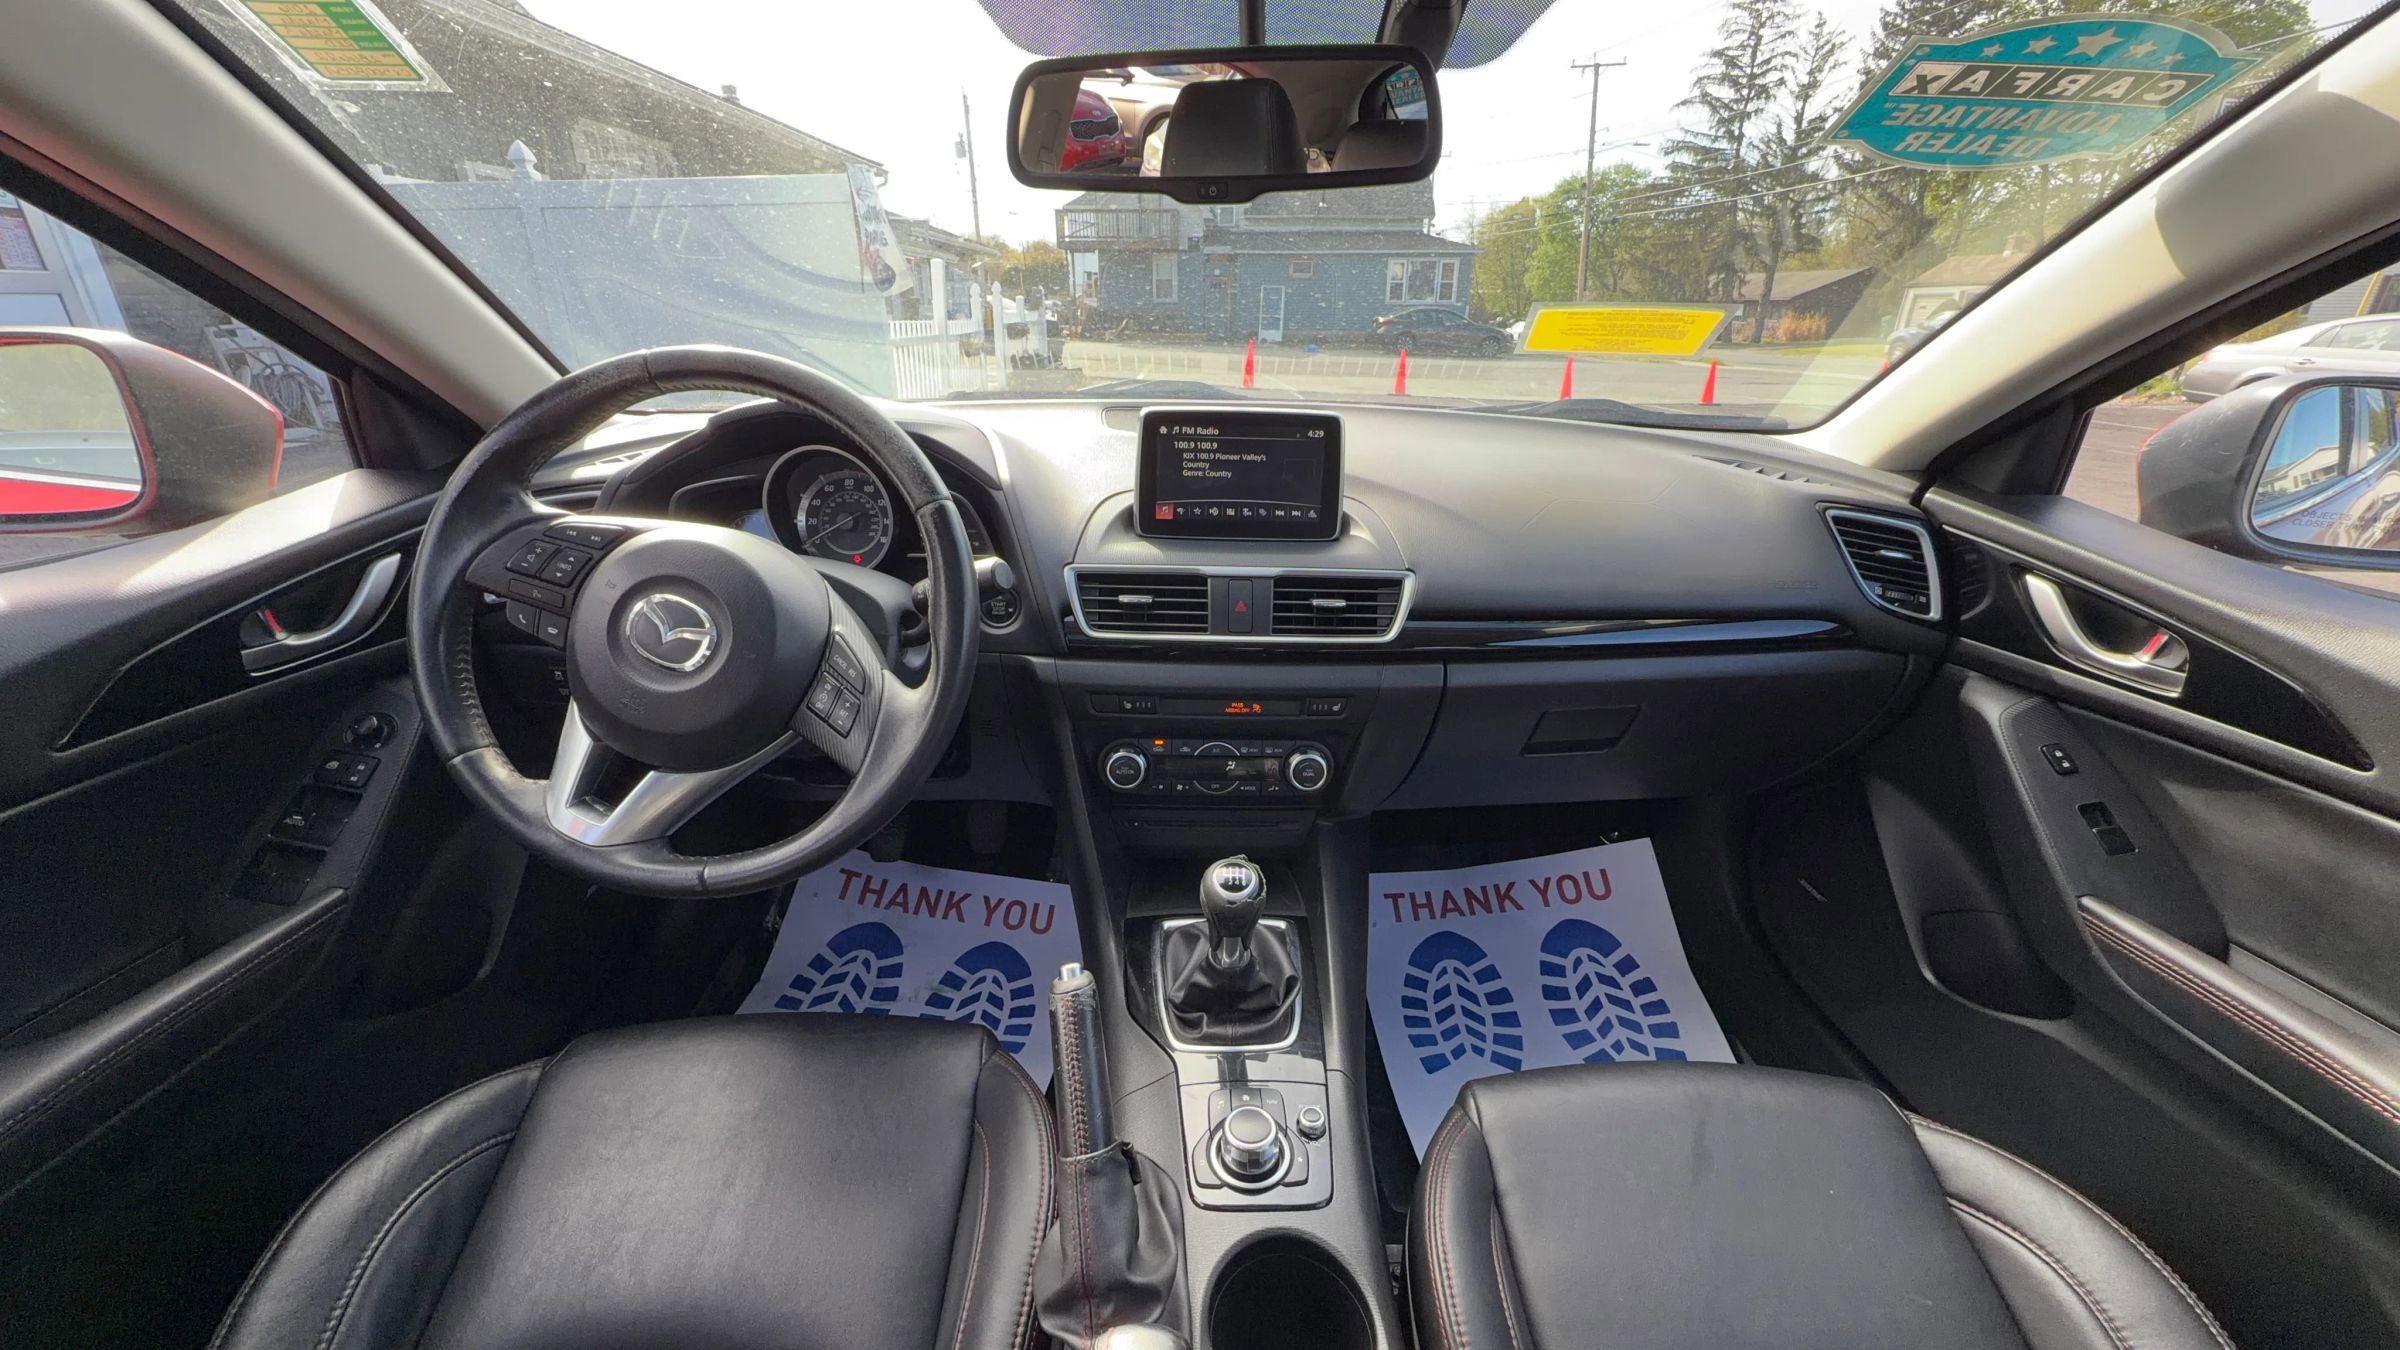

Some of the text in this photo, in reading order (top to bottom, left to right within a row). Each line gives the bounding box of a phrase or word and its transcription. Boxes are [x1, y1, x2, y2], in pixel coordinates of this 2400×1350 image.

[1182, 427, 1219, 435] FM Radio
[1307, 430, 1325, 438] 4:29
[1174, 441, 1218, 450] 100.9 100.9
[1215, 453, 1241, 461] Pioneer
[1242, 453, 1266, 462] Valley's
[1183, 461, 1210, 469] Country
[1205, 470, 1232, 478] Country
[2302, 510, 2352, 521] OBJECTS
[2291, 518, 2334, 528] CLOSER
[1383, 868, 1612, 923] THANK YOU
[838, 868, 1055, 934] THANK YOU
